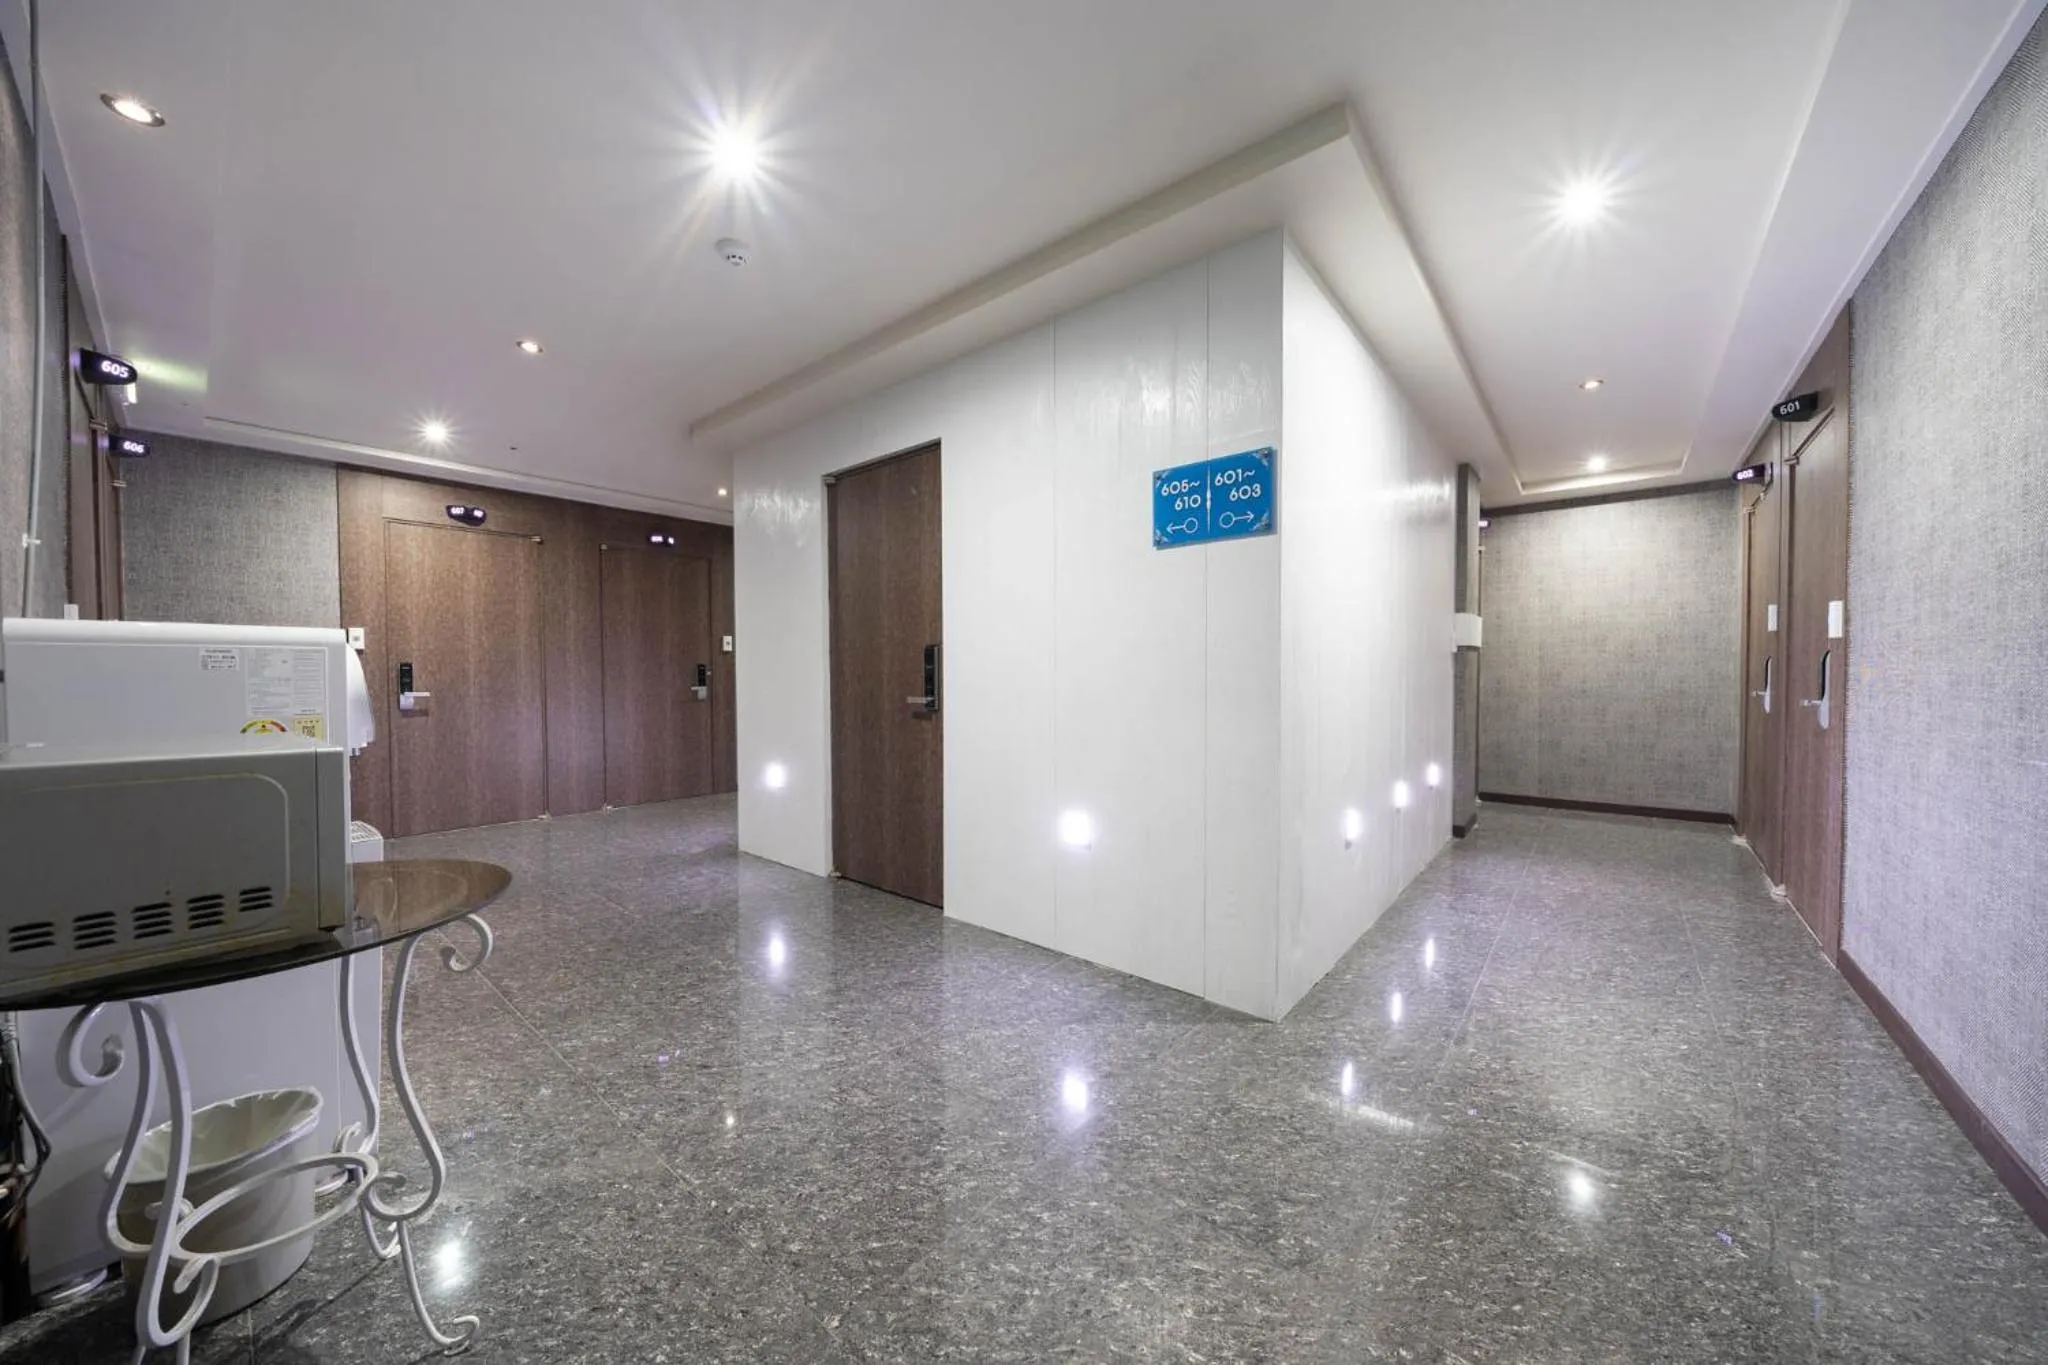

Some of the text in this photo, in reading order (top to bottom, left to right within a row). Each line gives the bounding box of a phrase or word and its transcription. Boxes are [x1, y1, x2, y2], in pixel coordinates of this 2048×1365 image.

[101, 360, 129, 378] 605
[1780, 401, 1800, 415] 601
[123, 440, 145, 453] 606
[1229, 483, 1261, 501] 603
[1174, 494, 1201, 511] 610
